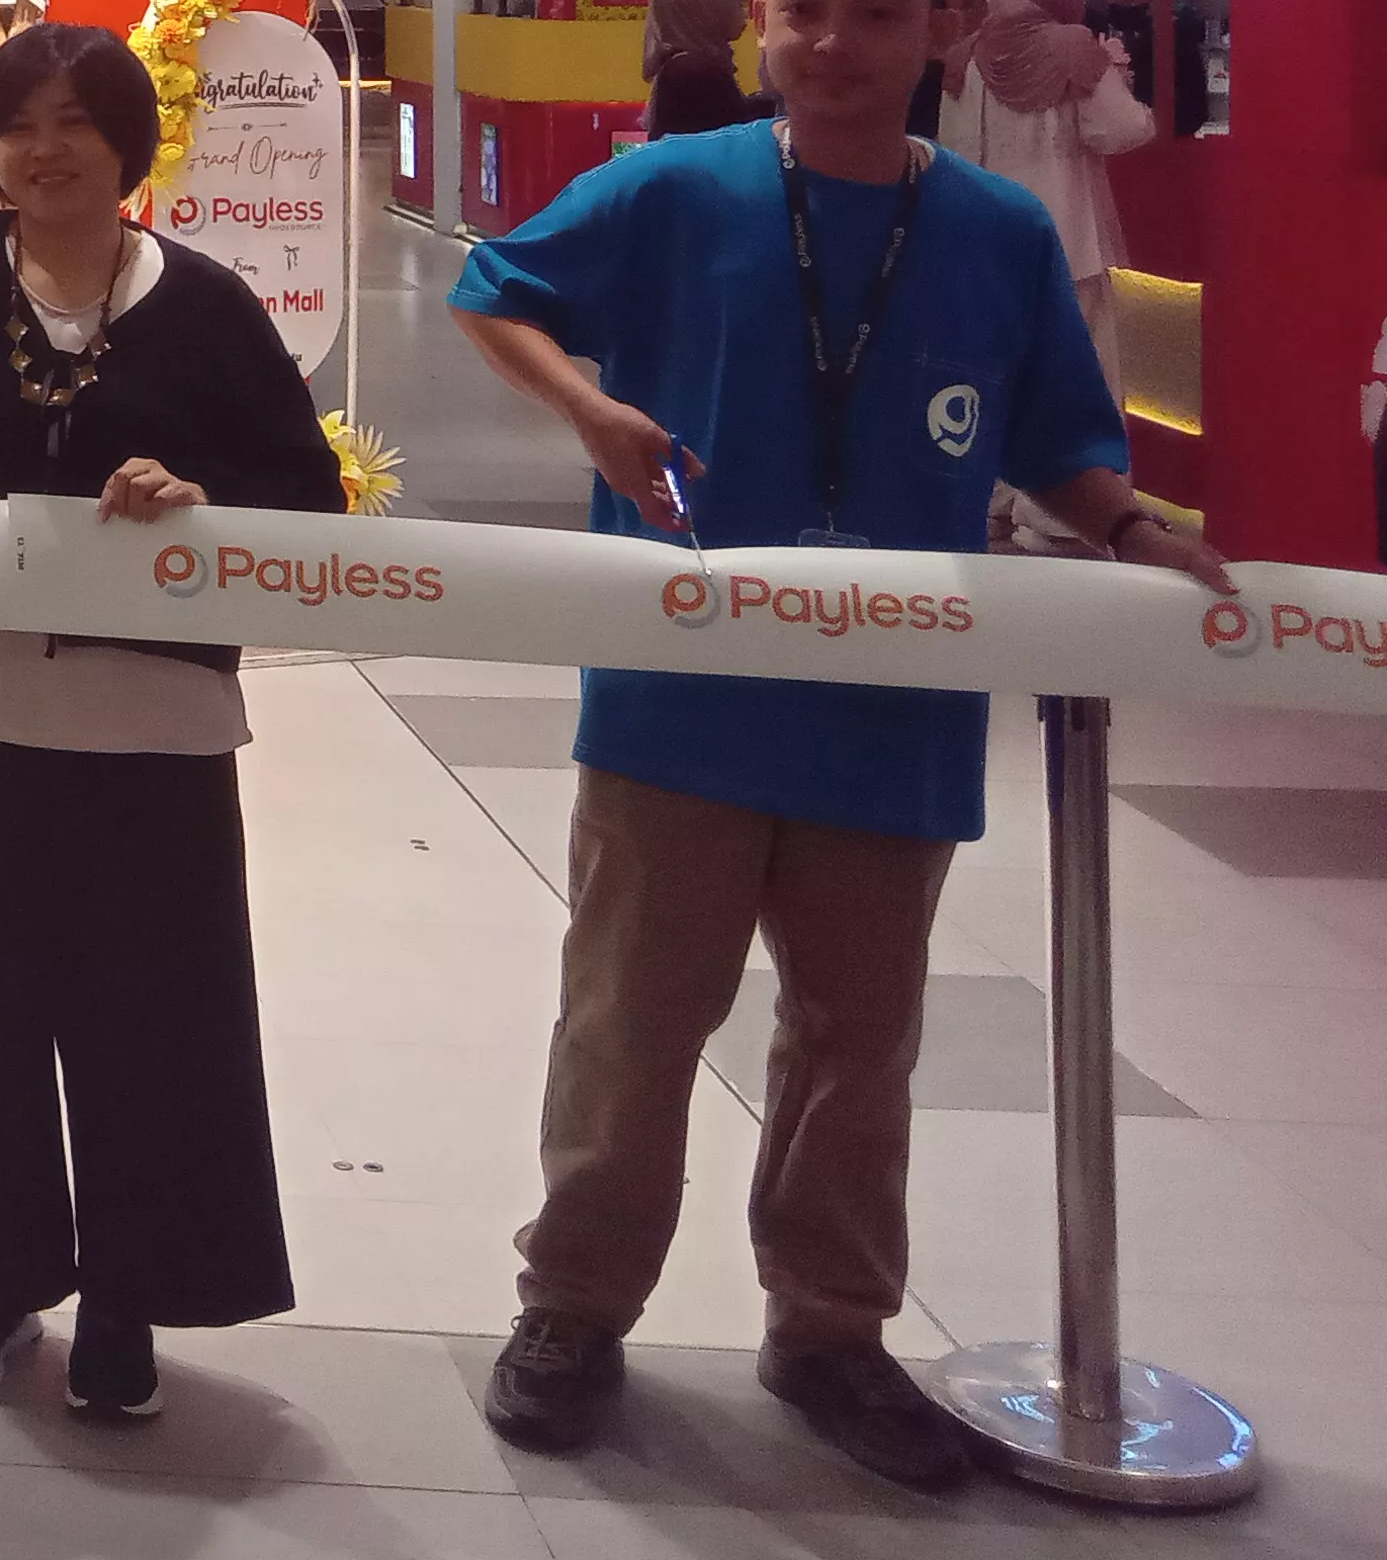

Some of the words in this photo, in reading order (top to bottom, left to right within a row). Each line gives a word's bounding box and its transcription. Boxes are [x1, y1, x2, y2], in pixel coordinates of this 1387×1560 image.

[249, 136, 330, 180] Opening
[212, 196, 324, 229] Payless
[283, 288, 325, 314] Mall
[217, 544, 446, 608] Payless
[728, 574, 975, 638] Payless
